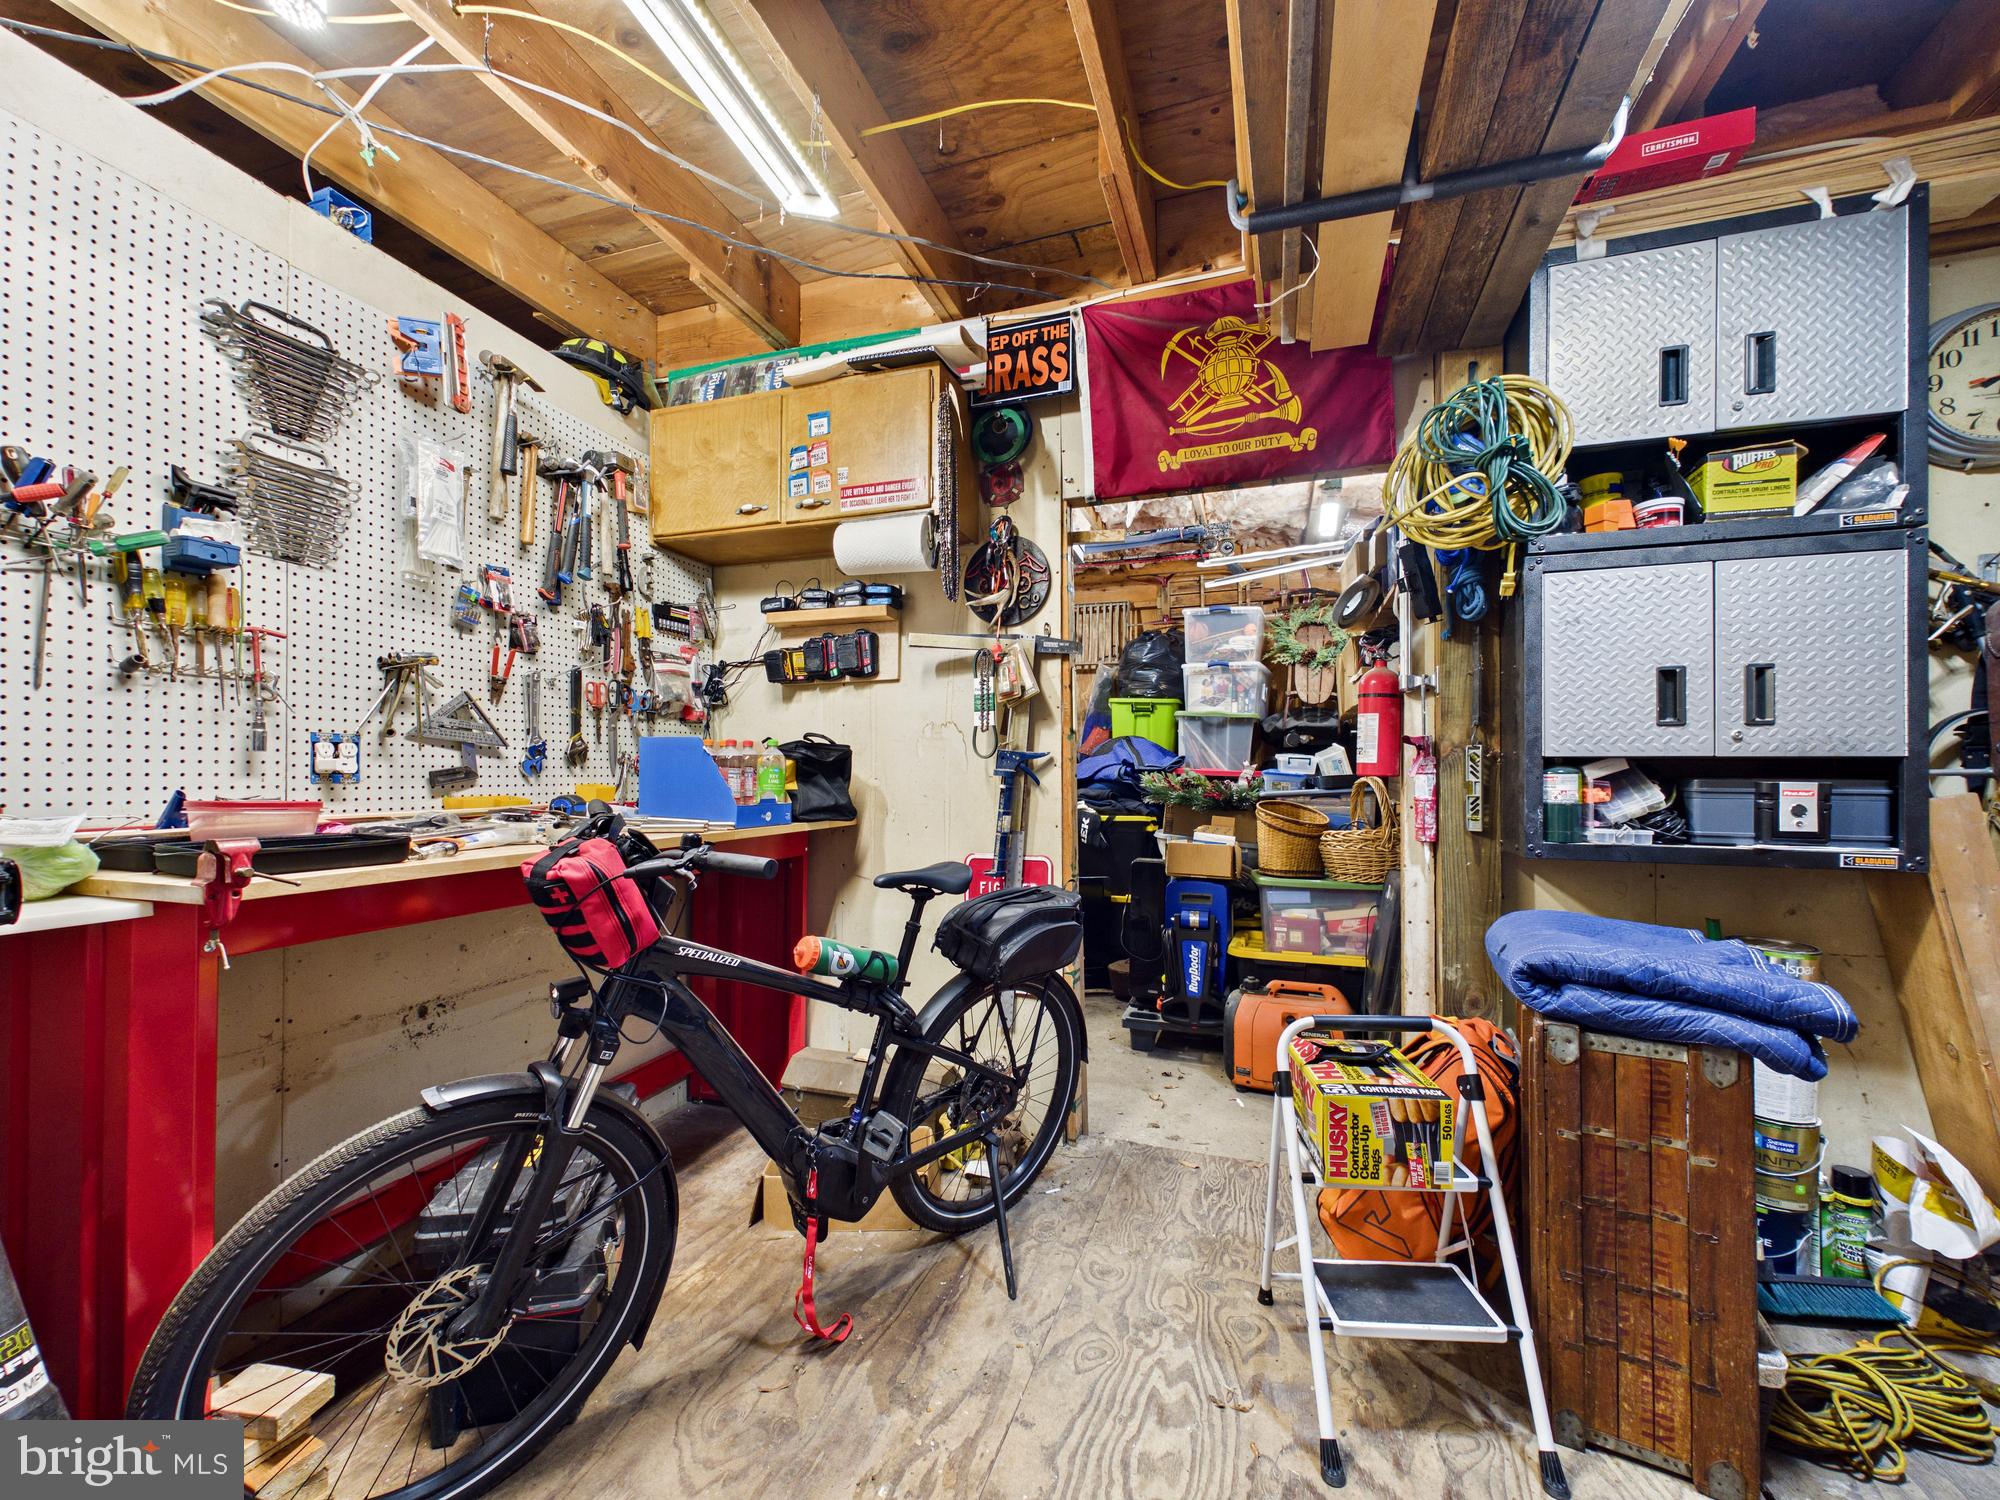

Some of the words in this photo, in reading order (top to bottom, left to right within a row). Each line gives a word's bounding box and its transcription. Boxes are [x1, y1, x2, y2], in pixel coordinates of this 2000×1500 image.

[1645, 135, 1696, 153] CRAFTSMAN
[989, 334, 1010, 352] EP
[1012, 328, 1038, 347] OFF
[1041, 323, 1069, 341] THE
[1962, 329, 1980, 348] 11
[1937, 349, 1962, 369] 10
[1928, 374, 1943, 392] 9
[1939, 397, 1956, 415] 8
[1967, 410, 1984, 430] 7
[1184, 447, 1214, 460] LOYAL
[1217, 445, 1229, 455] TO
[1232, 442, 1251, 453] OUR
[1255, 436, 1282, 446] DUTY
[1732, 450, 1776, 471] RUFFIES
[1754, 460, 1775, 470] PRO
[1712, 487, 1750, 496] CONTRACTOR
[1855, 857, 1896, 865] GLADIATOR
[675, 946, 741, 967] SPECIALIZED
[1301, 1031, 1329, 1039] GENERAC
[1360, 1085, 1419, 1096] CONTRACTOR
[1420, 1088, 1444, 1097] PACK
[1444, 1103, 1452, 1125] BAGS
[1328, 1101, 1348, 1178] HUSKY
[1442, 1126, 1452, 1140] 50
[1350, 1112, 1359, 1179] Contractor
[1360, 1124, 1371, 1179] Clean-Up
[1370, 1149, 1382, 1180] Bags
